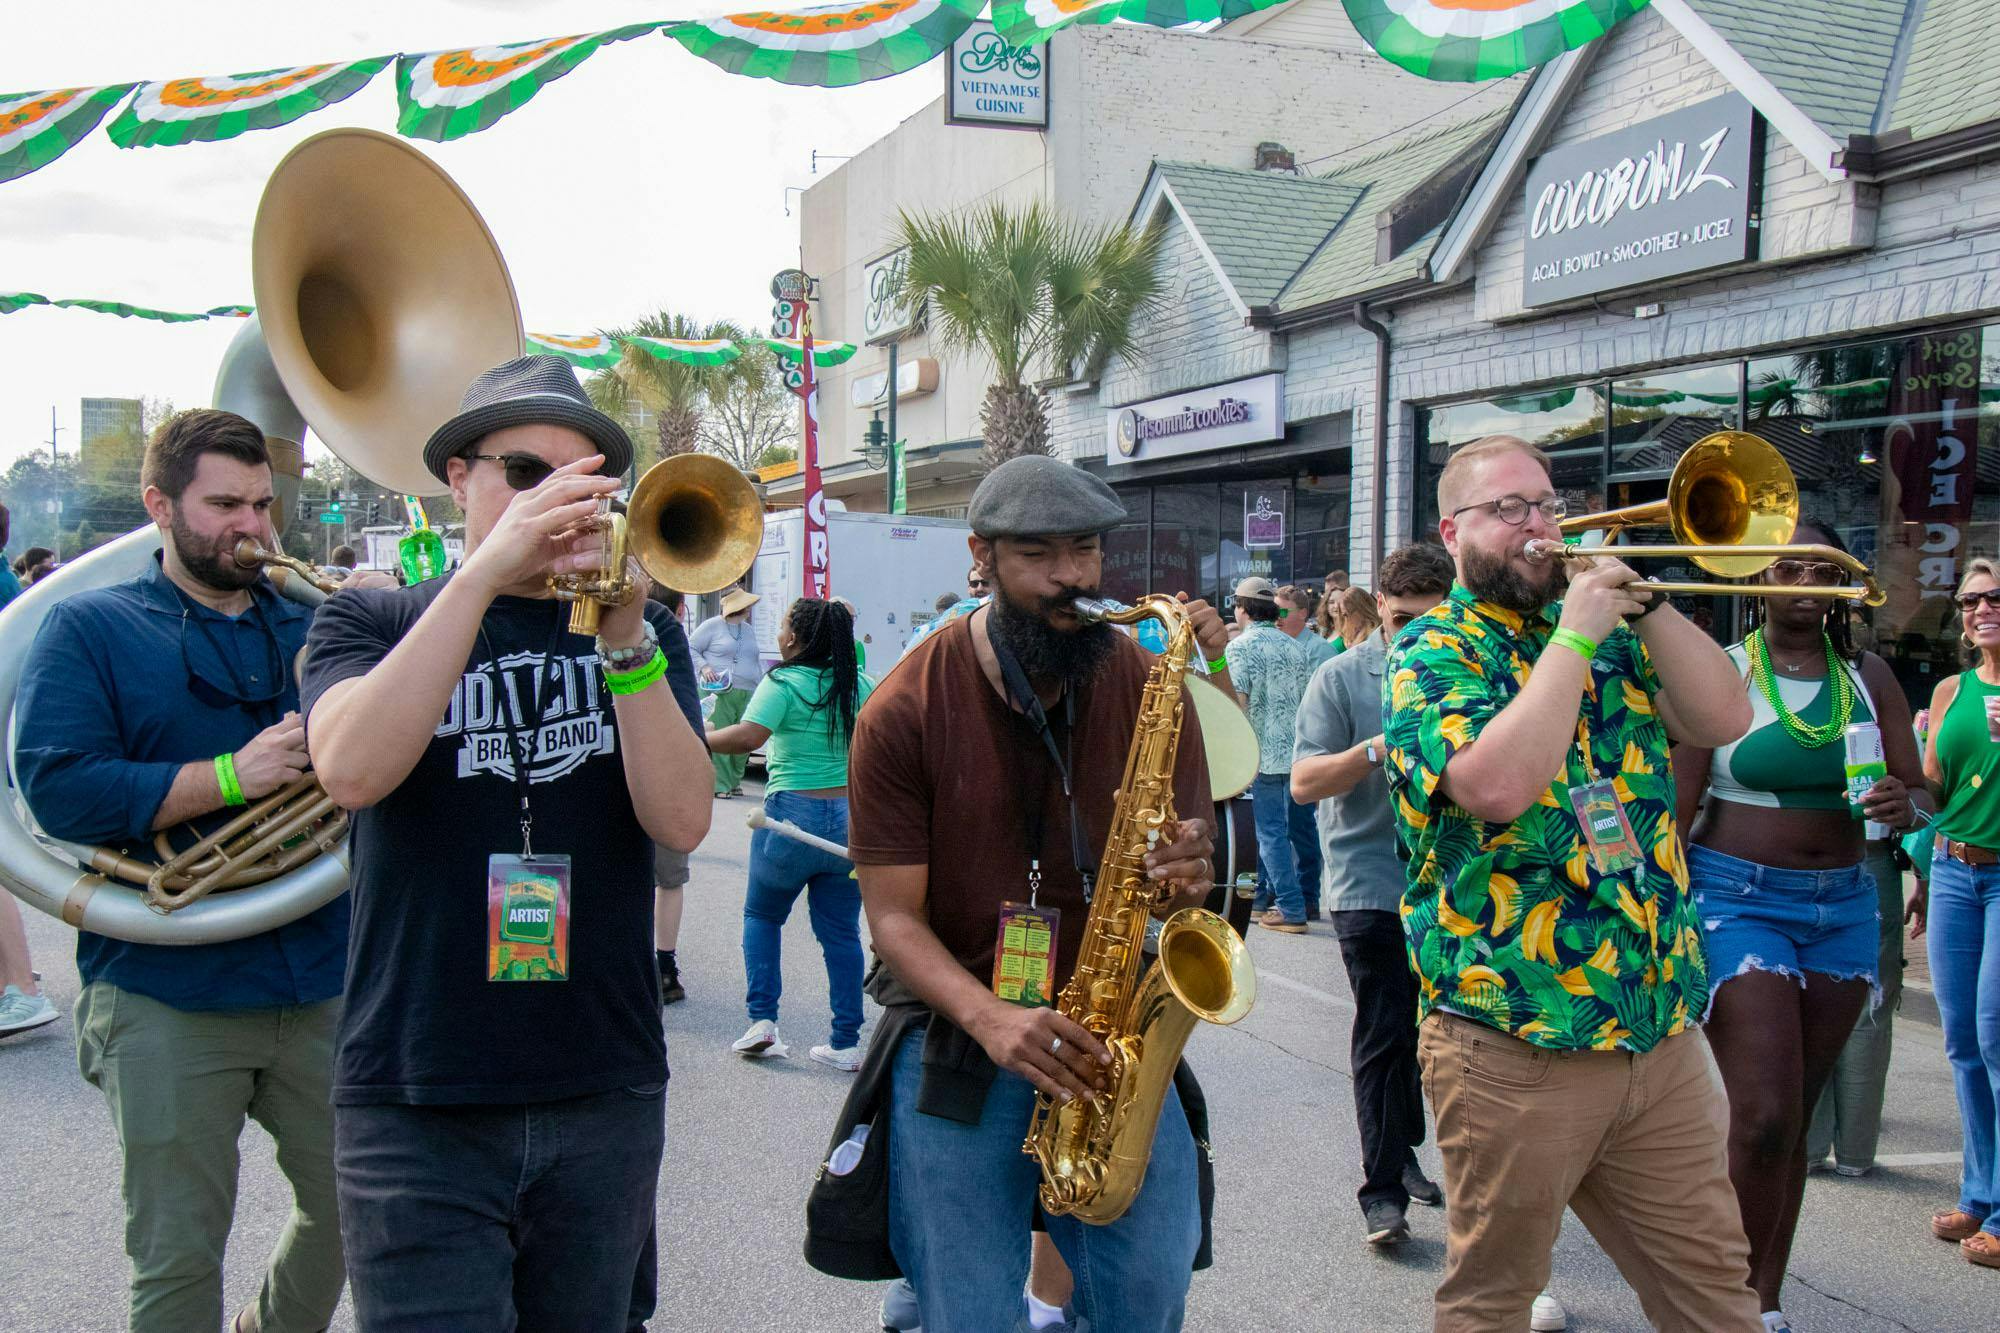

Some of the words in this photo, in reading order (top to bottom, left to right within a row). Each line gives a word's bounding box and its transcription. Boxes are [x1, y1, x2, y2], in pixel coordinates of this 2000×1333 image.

[961, 80, 1041, 98] VIETNAMESE
[976, 98, 1025, 114] CUISINE
[1531, 126, 1737, 239] COCOBOWLZ
[1532, 260, 1561, 282] ACAI
[1564, 251, 1603, 275] BOWLZ
[1612, 231, 1681, 263] SMOOTHIEZ
[1692, 218, 1732, 244] JUICEZ
[1196, 397, 1246, 428] cookies
[1237, 560, 1272, 573] WARM
[533, 654, 602, 722] CIT
[545, 720, 598, 754] BAND
[1593, 815, 1618, 832] ARTIST
[509, 908, 551, 923] ARTIST
